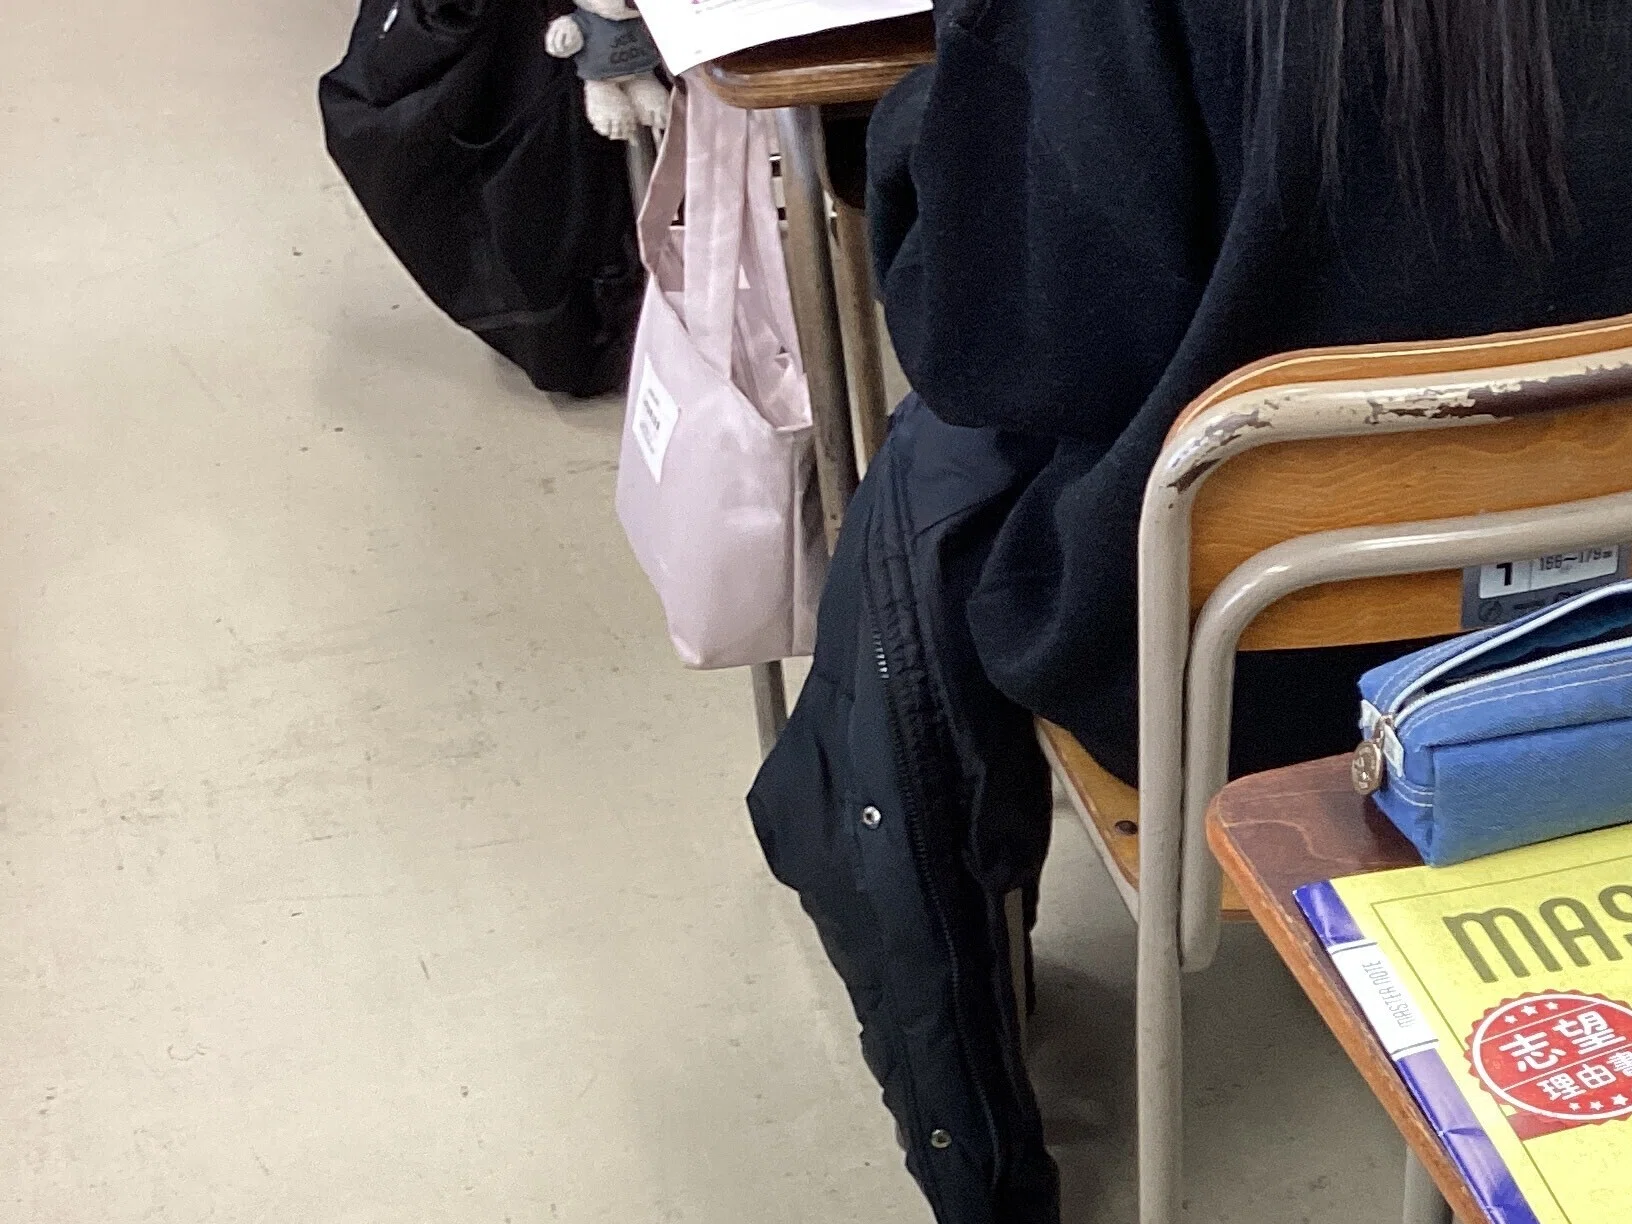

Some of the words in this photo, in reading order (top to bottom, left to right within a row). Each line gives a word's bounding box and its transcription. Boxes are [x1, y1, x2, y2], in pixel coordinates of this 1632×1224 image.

[1361, 960, 1392, 985] NOTE
[1378, 985, 1417, 1028] MASTER
[1498, 1010, 1627, 1072] 志望
